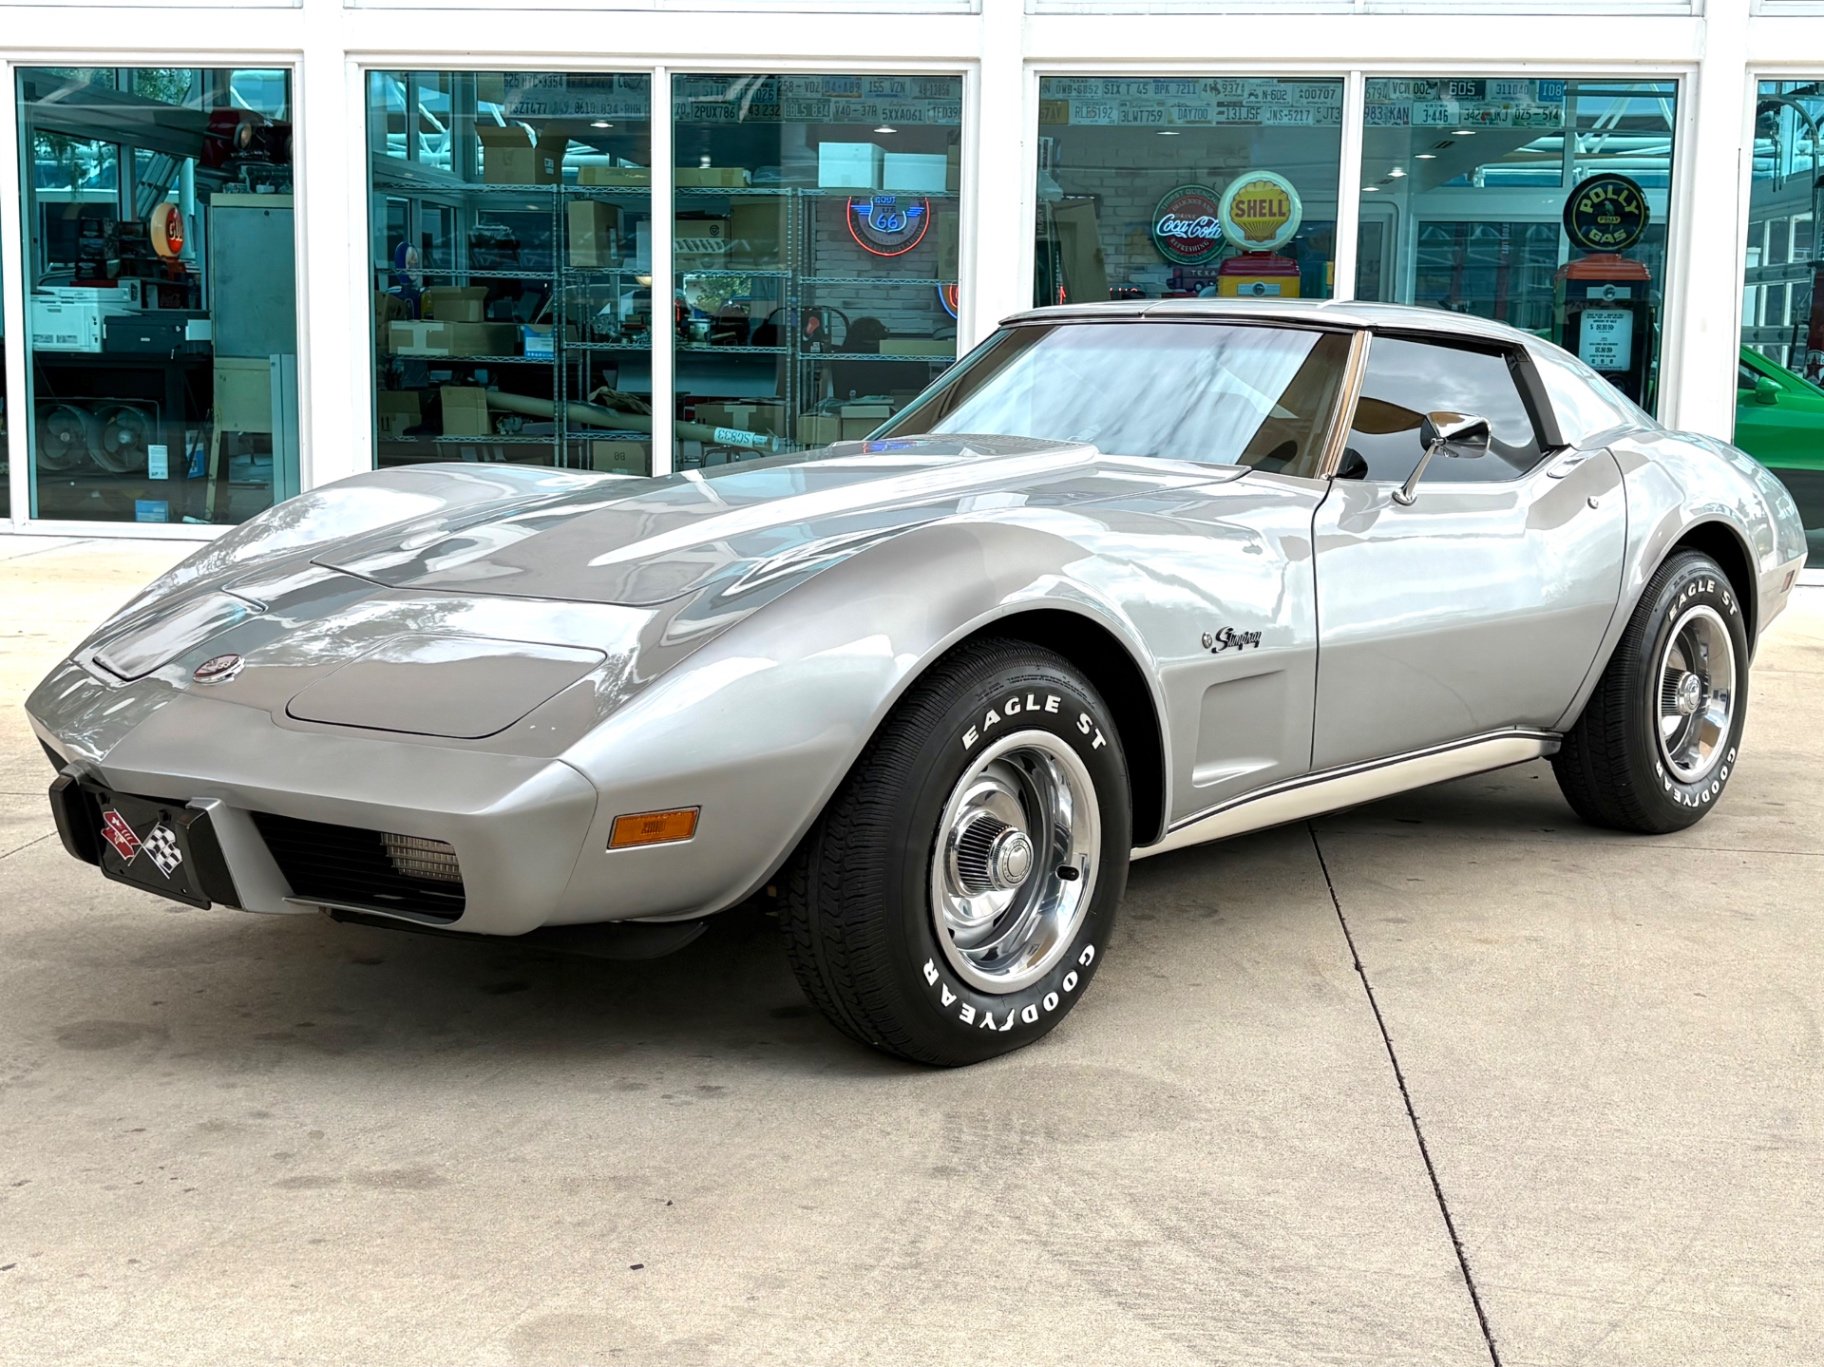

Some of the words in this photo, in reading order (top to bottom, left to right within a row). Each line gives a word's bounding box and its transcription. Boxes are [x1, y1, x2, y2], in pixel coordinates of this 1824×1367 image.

[1234, 198, 1287, 218] SHELL
[1579, 185, 1640, 215] POLLY
[876, 213, 899, 230] 66
[1156, 213, 1222, 239] Coca-Cola
[1588, 228, 1628, 244] GAS
[1667, 579, 1716, 622] EAGLE
[1721, 589, 1738, 617] ST
[960, 693, 1062, 751] EAGLE
[1075, 711, 1108, 751] ST
[1653, 746, 1737, 808] GOODYEAR
[922, 943, 1096, 1033] GOODYEAR
